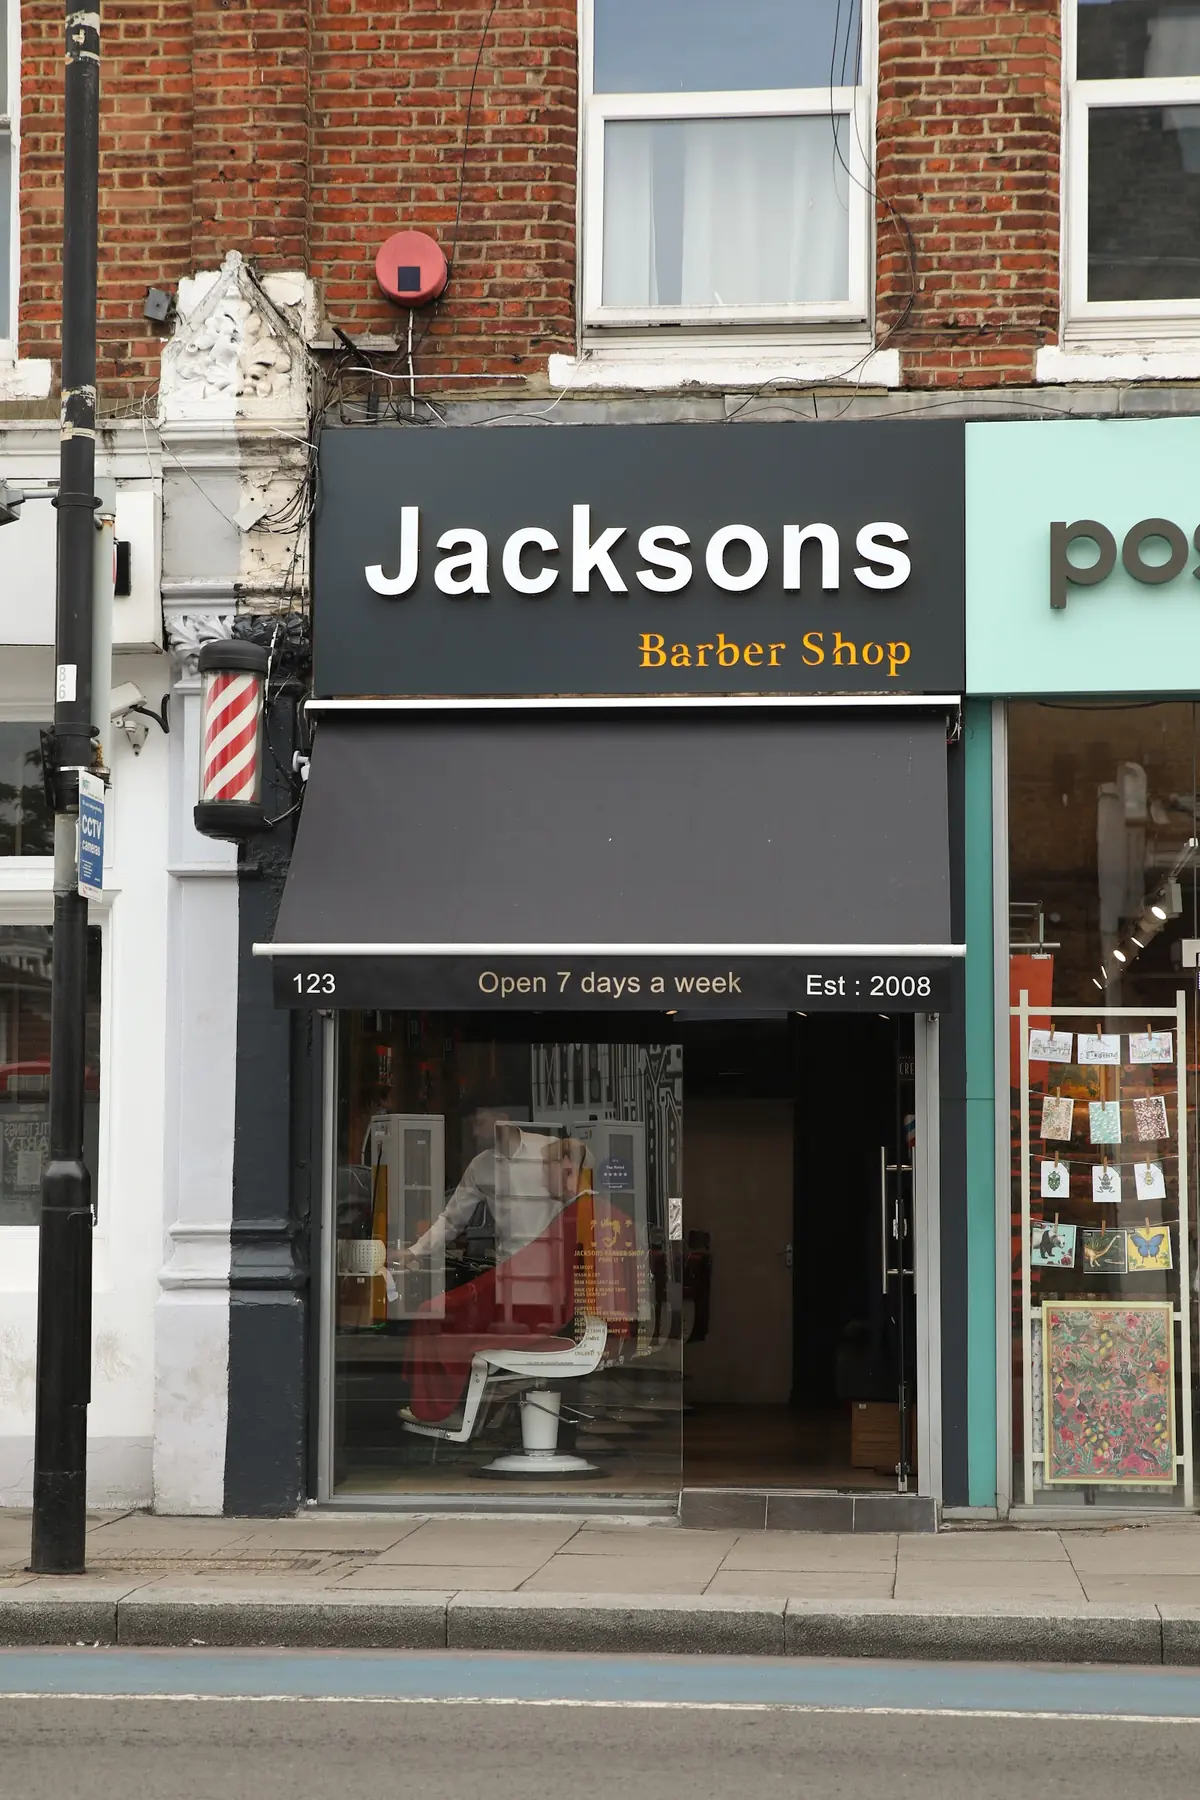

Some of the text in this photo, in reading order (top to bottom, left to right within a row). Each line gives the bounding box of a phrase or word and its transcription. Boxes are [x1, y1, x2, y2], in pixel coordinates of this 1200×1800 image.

[365, 504, 911, 596] Jacksons
[1050, 518, 1200, 610] po
[639, 632, 911, 678] Barber Shop
[82, 814, 102, 840] CCTV
[81, 840, 101, 857] cameras
[292, 973, 336, 994] 123
[478, 971, 742, 999] Open 7 days a week
[806, 974, 846, 996] Est
[869, 975, 931, 997] 2008
